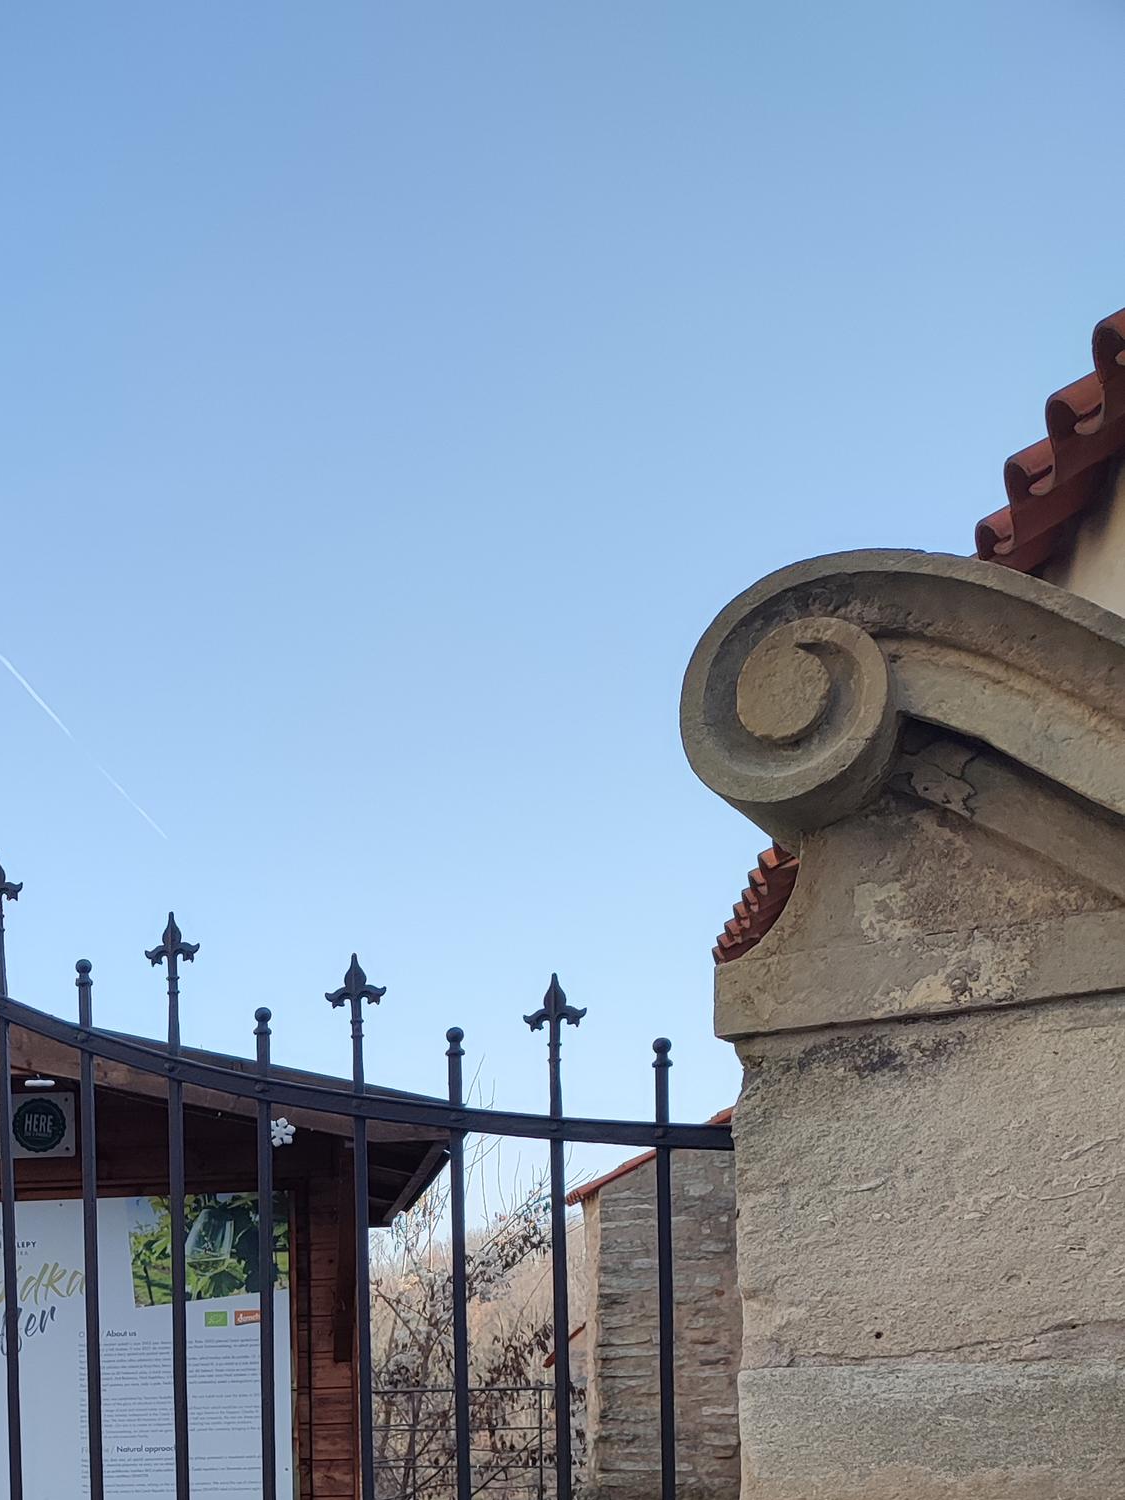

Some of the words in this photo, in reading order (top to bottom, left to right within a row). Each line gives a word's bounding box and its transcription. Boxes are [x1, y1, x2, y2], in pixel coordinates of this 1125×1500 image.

[25, 1113, 54, 1133] HERE
[106, 1330, 127, 1338] About
[116, 1445, 143, 1453] Natural
[144, 1446, 175, 1455] approac
